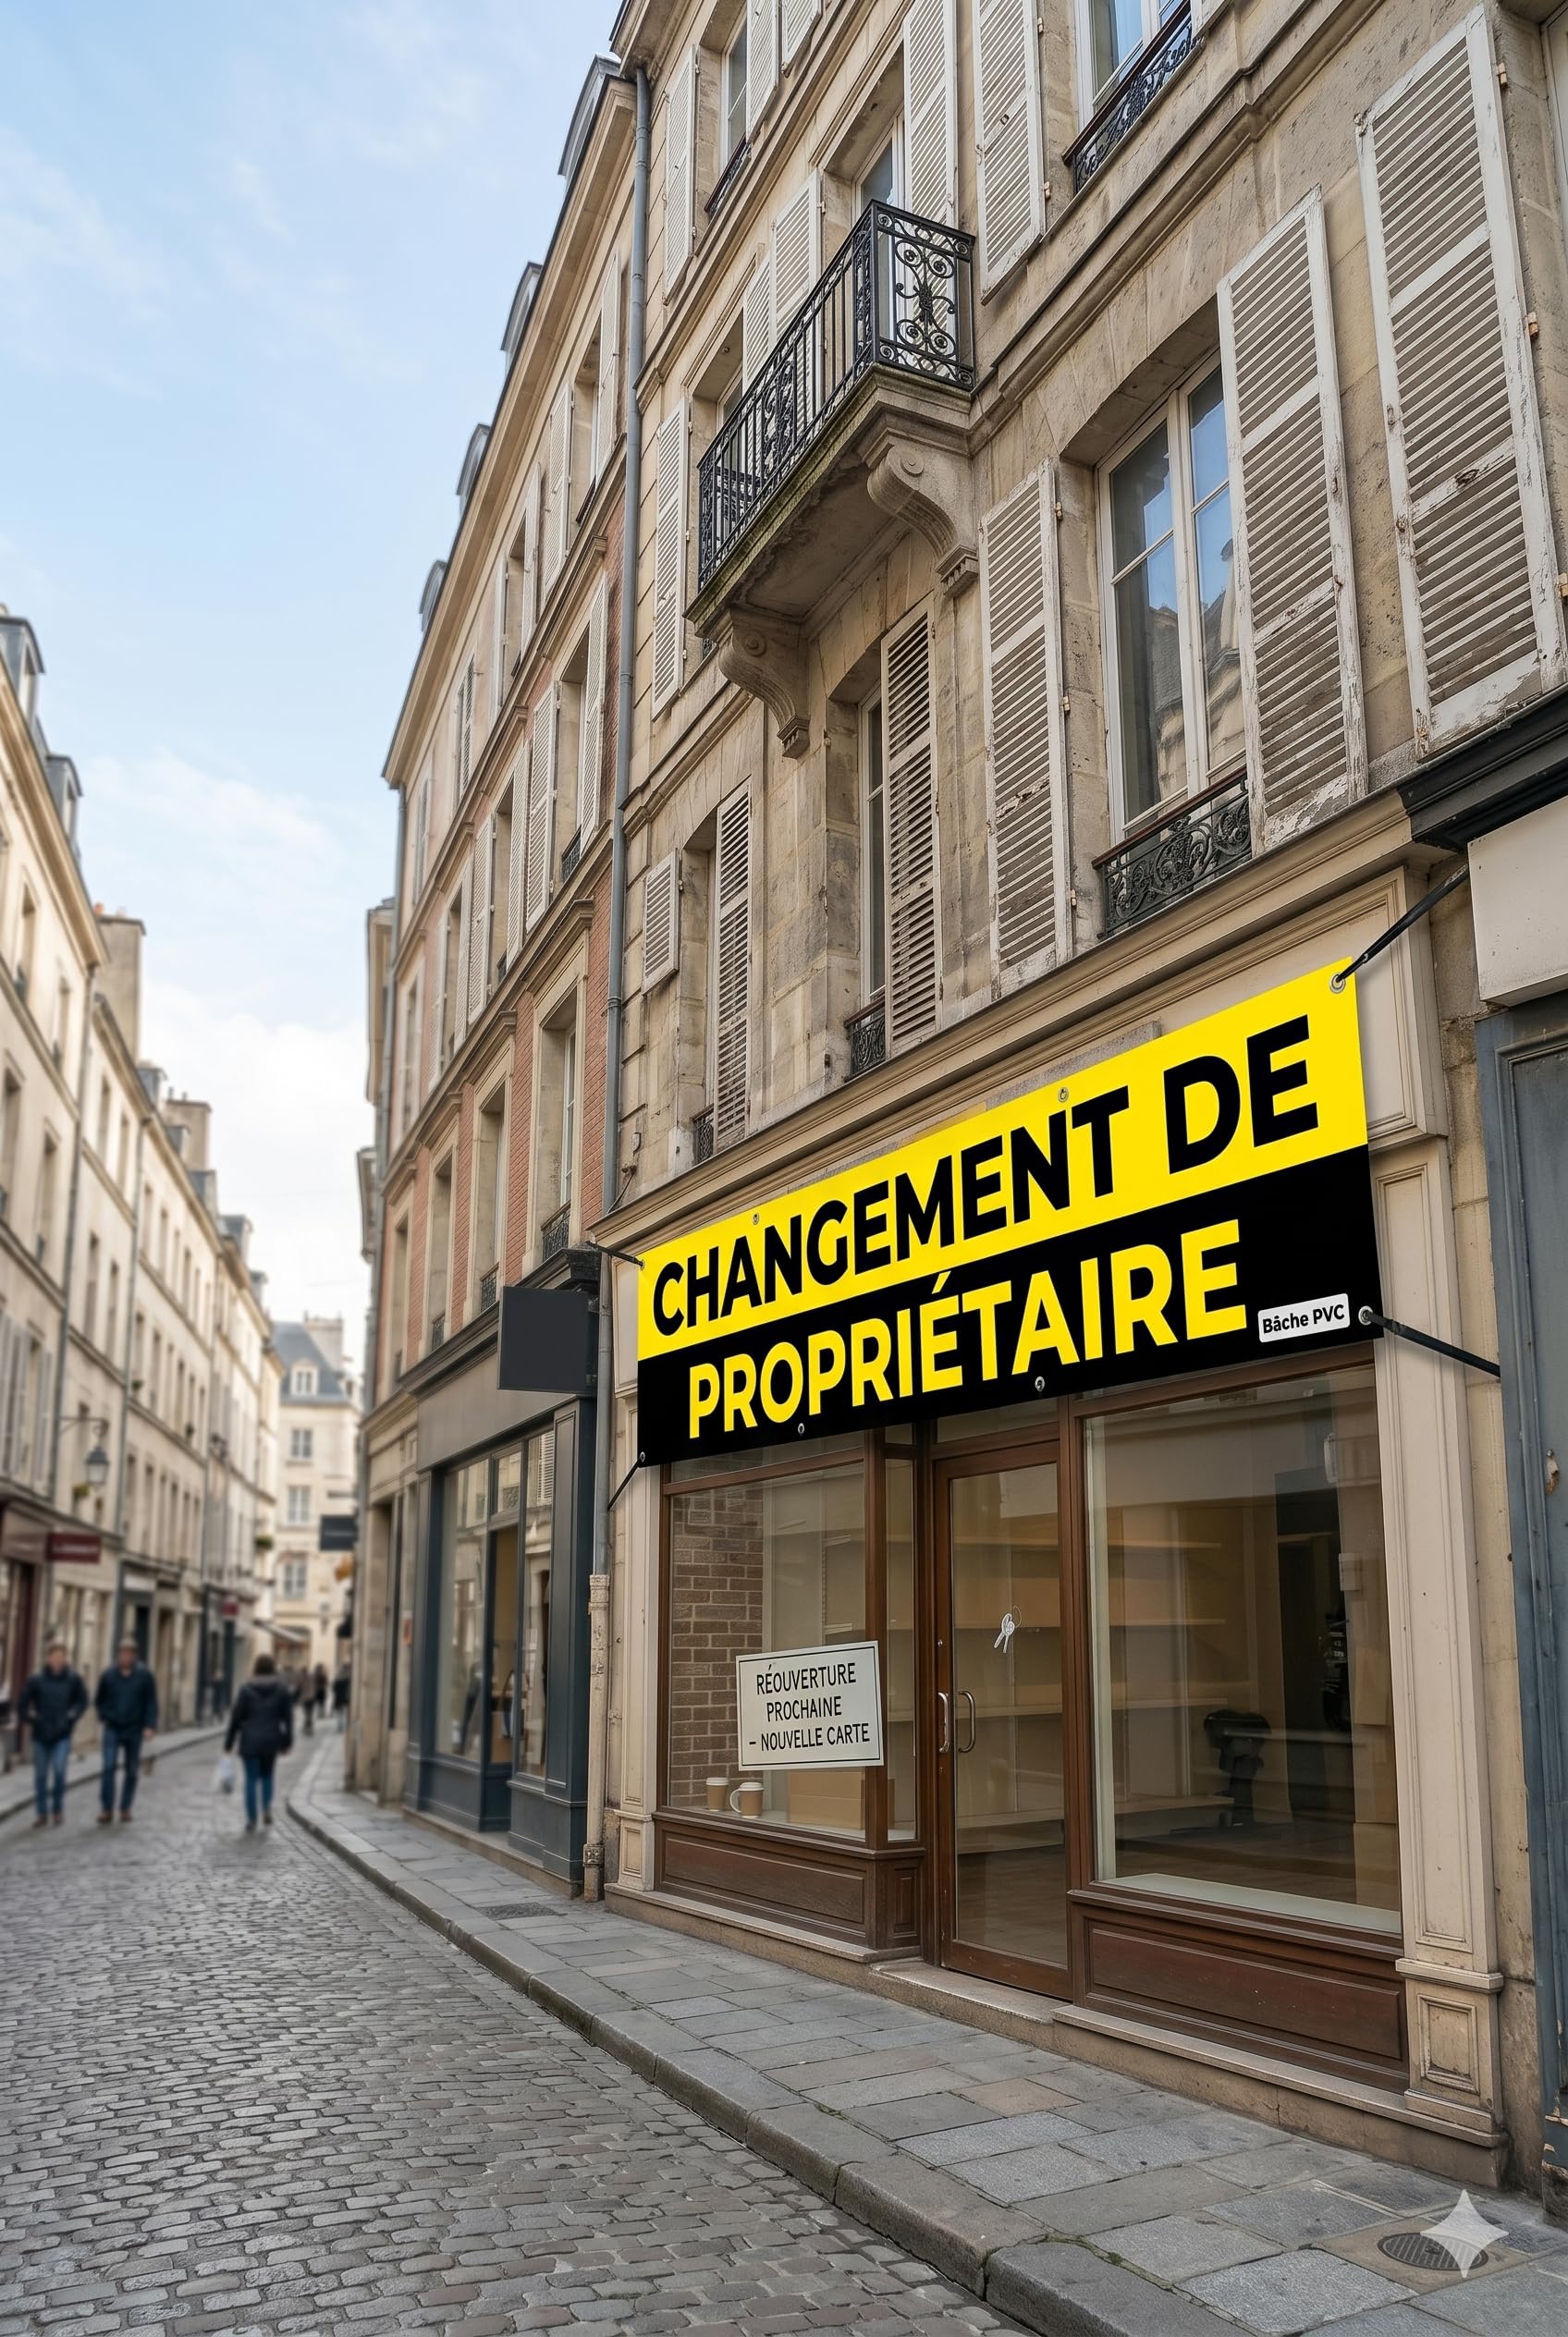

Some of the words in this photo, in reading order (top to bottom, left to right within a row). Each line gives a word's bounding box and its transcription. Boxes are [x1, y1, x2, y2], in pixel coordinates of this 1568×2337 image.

[653, 1085, 1130, 1337] CHANGEMENT
[1163, 1014, 1319, 1175] DE
[688, 1218, 1247, 1439] PROPRIÉTAIRE
[1312, 1303, 1345, 1325] PVC
[756, 1662, 857, 1695] RÉOUVERTURE
[766, 1695, 842, 1723] PROCHAINE
[761, 1727, 824, 1752] NOUVELLE
[827, 1722, 871, 1746] CARTE
